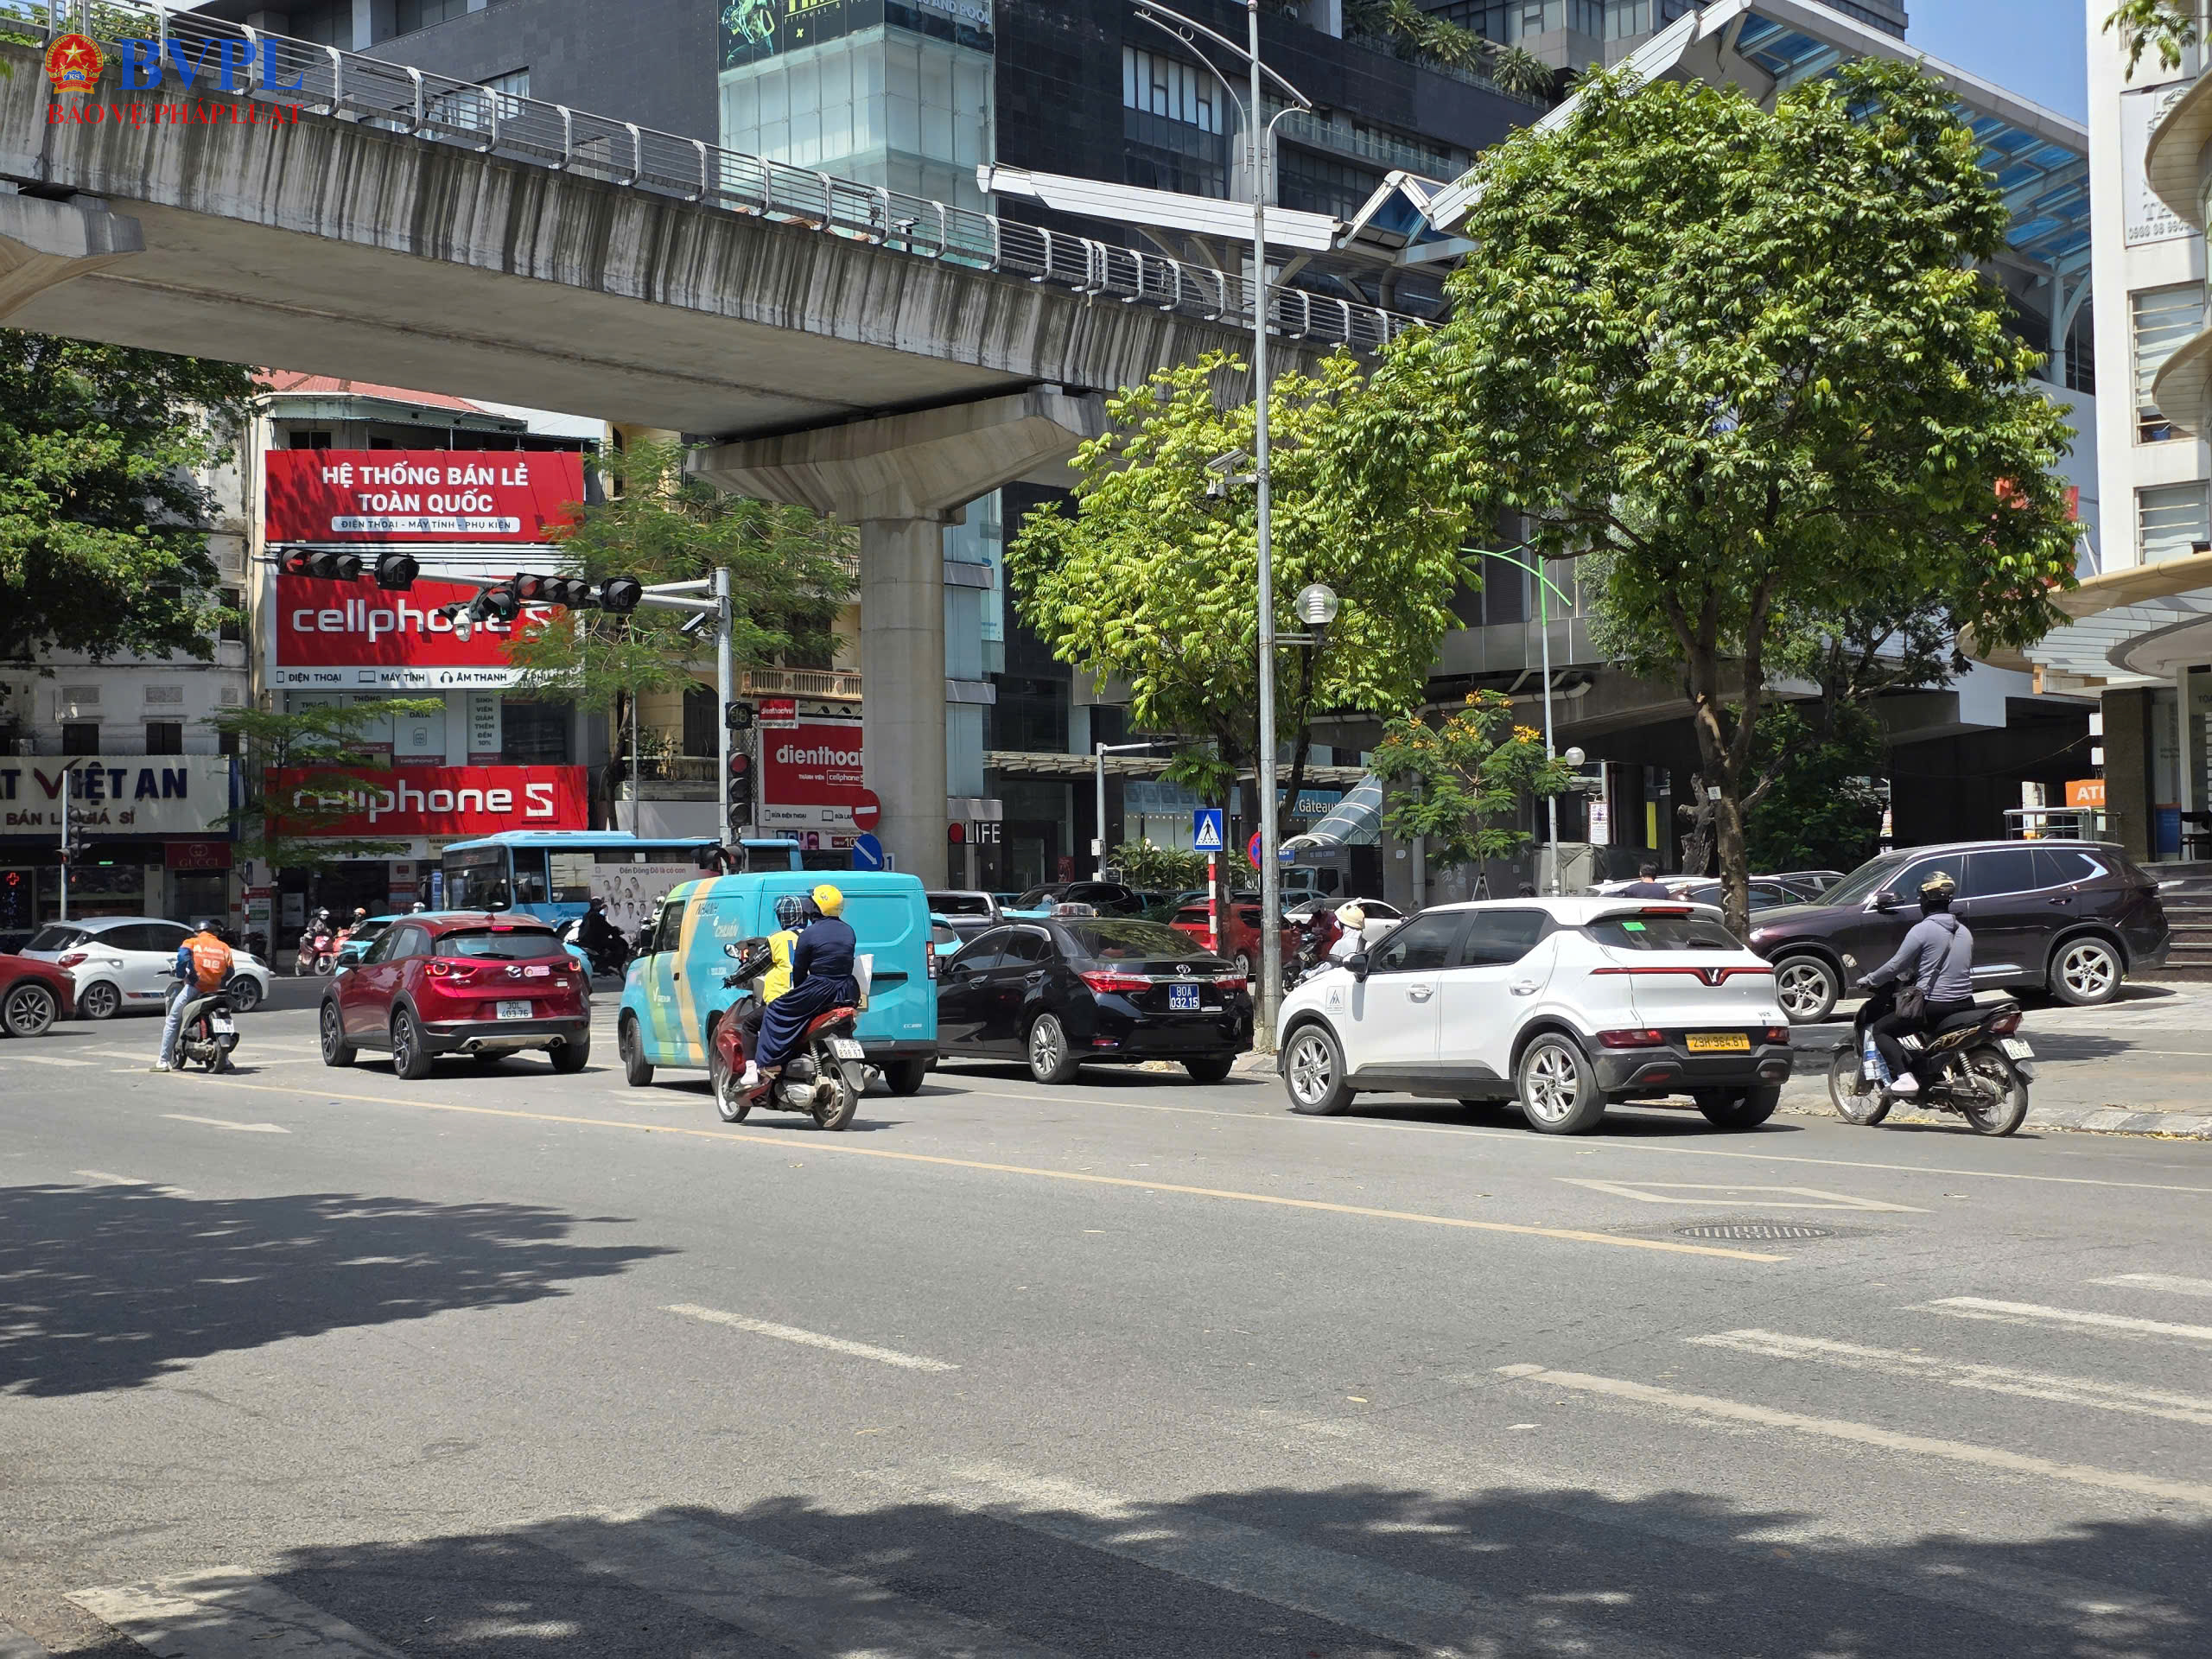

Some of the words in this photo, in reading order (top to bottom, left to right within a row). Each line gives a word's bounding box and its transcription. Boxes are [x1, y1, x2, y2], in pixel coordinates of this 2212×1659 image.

[322, 462, 353, 488] HỆ
[359, 461, 440, 486] THỐNG
[448, 463, 494, 486] BÁN
[501, 462, 529, 486] LẺ
[358, 490, 421, 512] TOÀN
[428, 488, 493, 513] QUỐC
[340, 520, 365, 530] ĐIỆN
[368, 521, 398, 530] THOẠI
[409, 519, 429, 529] MÁY
[432, 520, 454, 529] TÍNH
[465, 521, 484, 530] PHỤ
[489, 520, 511, 530] KIỆN
[289, 671, 310, 683] ĐIỆN
[314, 672, 342, 684] THOẠI
[381, 671, 401, 683] MÁY
[404, 671, 425, 683] TÍNH
[456, 671, 474, 682] ÂM
[475, 673, 507, 682] THANH
[0, 769, 21, 799] T
[135, 768, 187, 799] AN
[6, 809, 42, 825] BÁN
[965, 823, 1001, 843] LIFE
[180, 858, 218, 867] GUCCI
[1176, 986, 1192, 996] 80A
